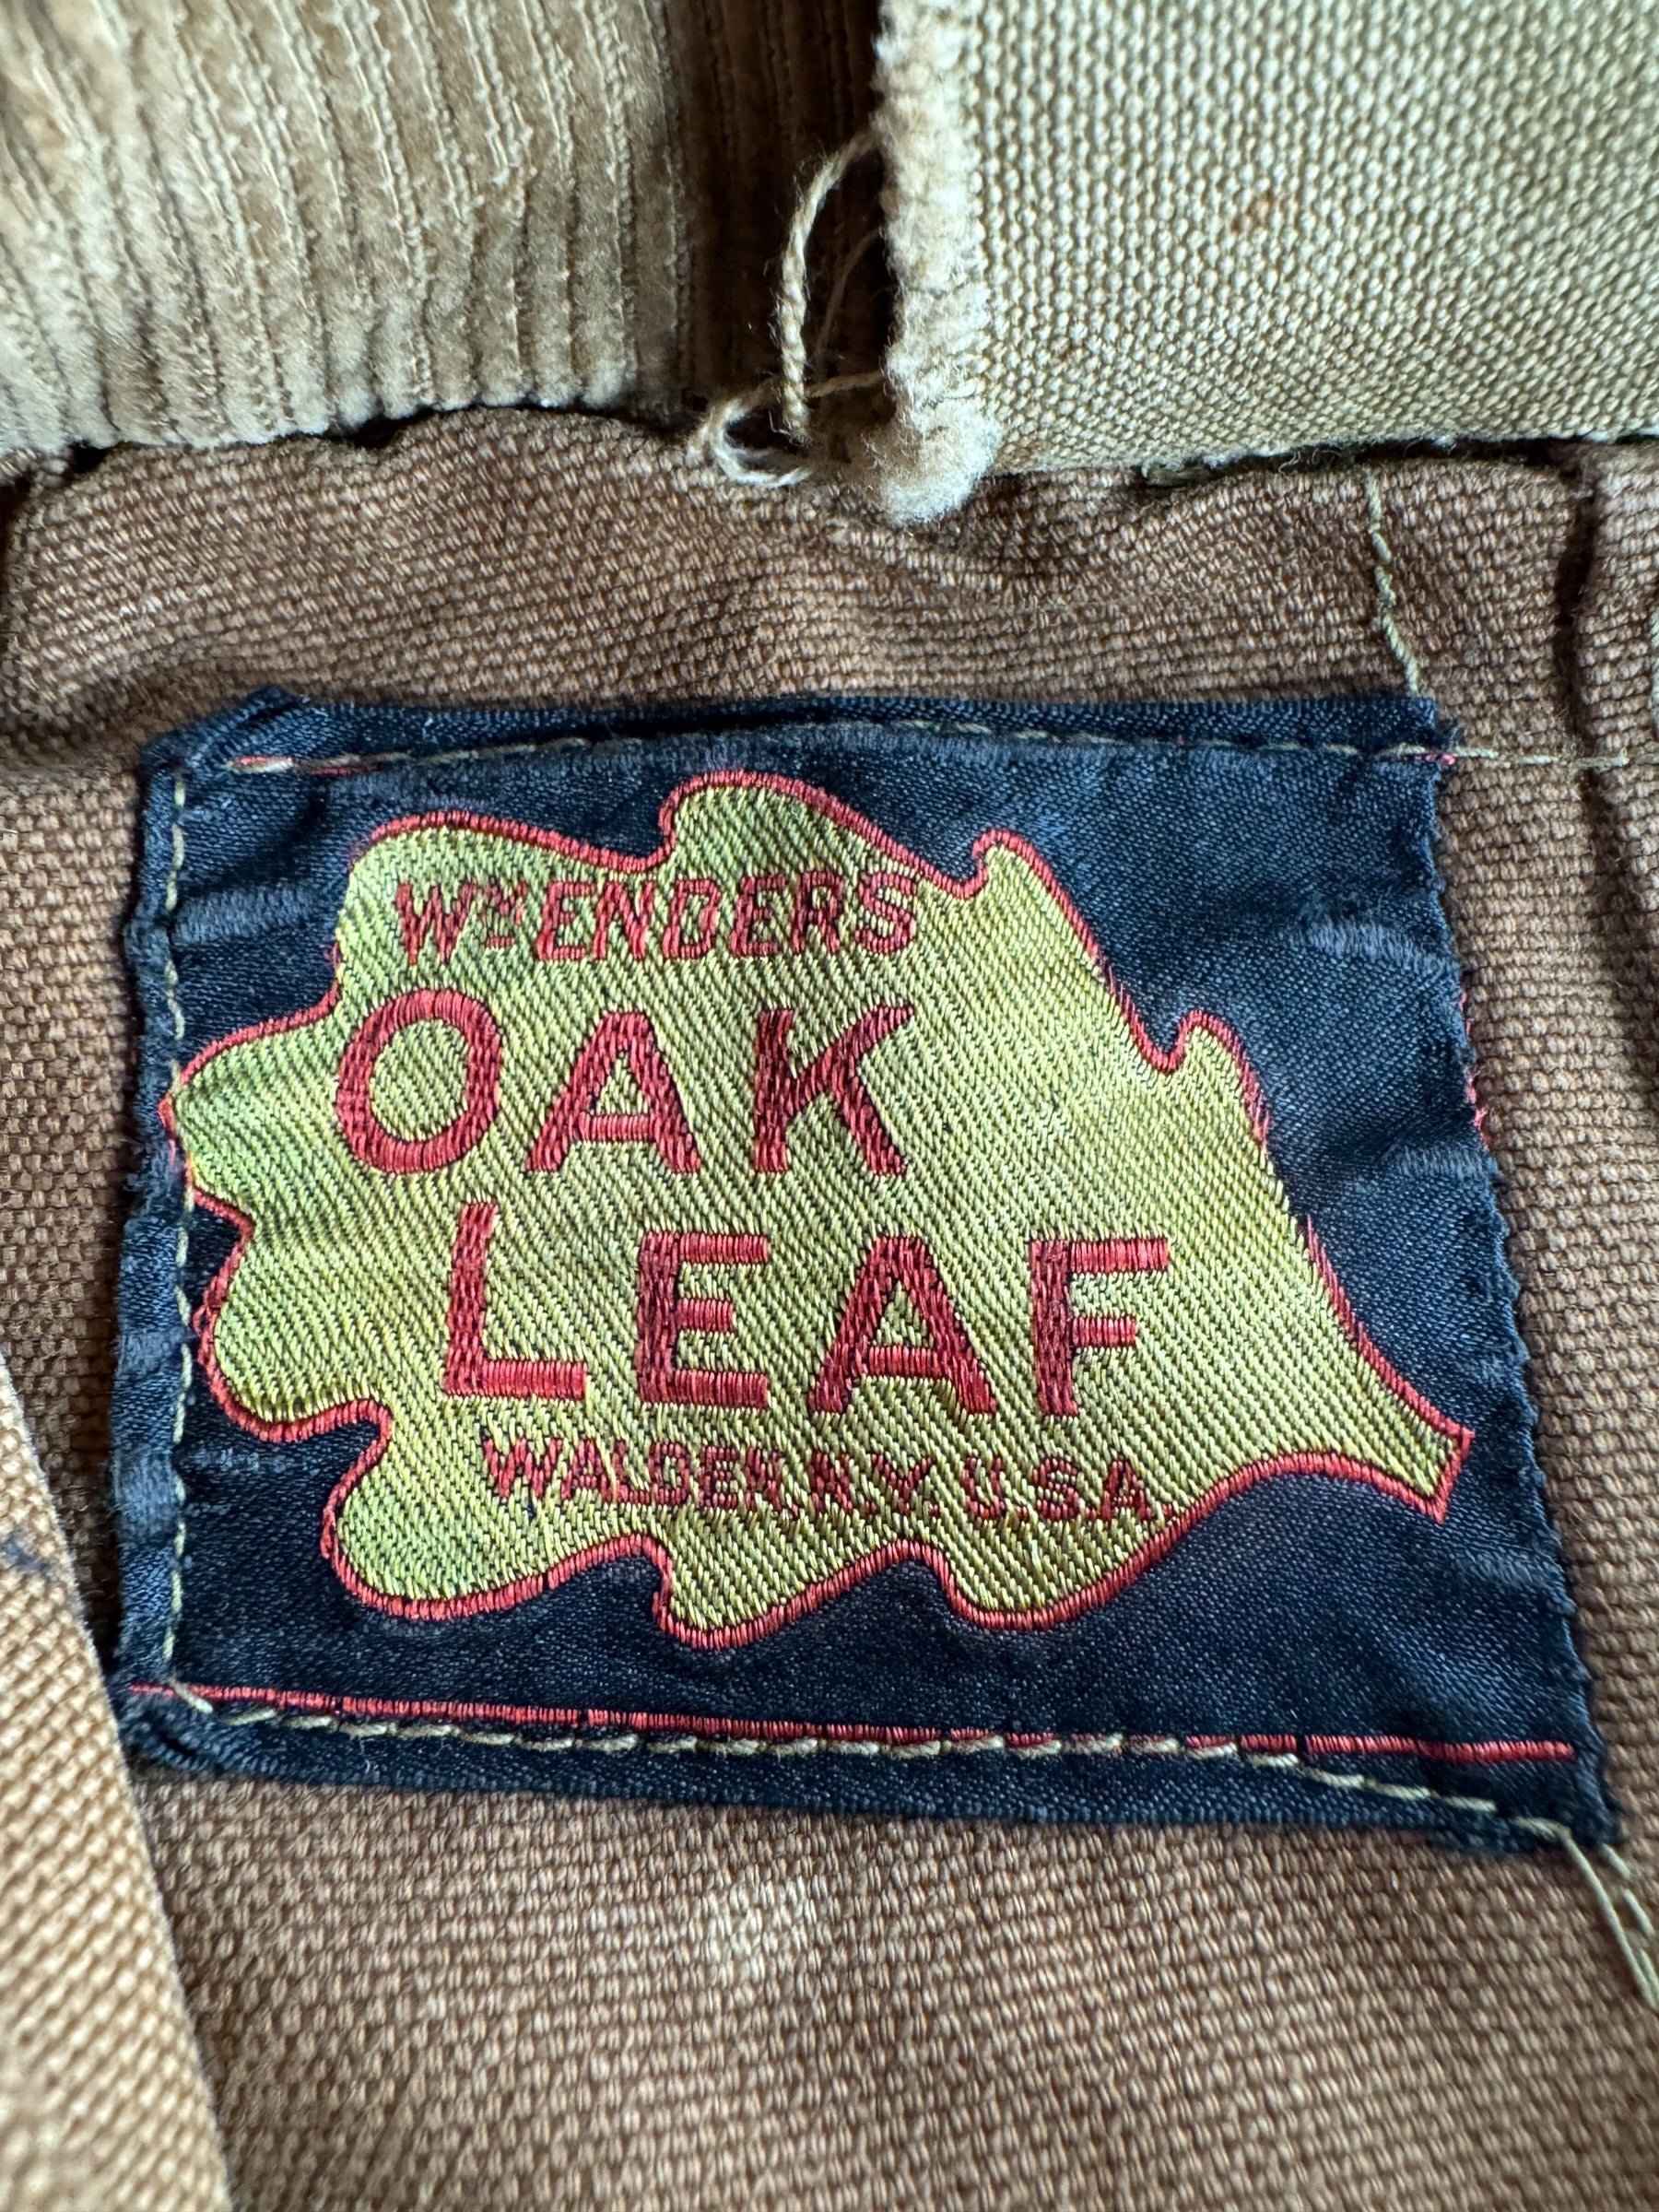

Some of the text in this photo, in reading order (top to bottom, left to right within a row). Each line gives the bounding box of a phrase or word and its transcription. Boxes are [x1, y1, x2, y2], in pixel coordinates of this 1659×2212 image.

[536, 870, 919, 961] ENDERS
[335, 986, 913, 1176] OAK
[441, 1201, 1170, 1418] LEAF
